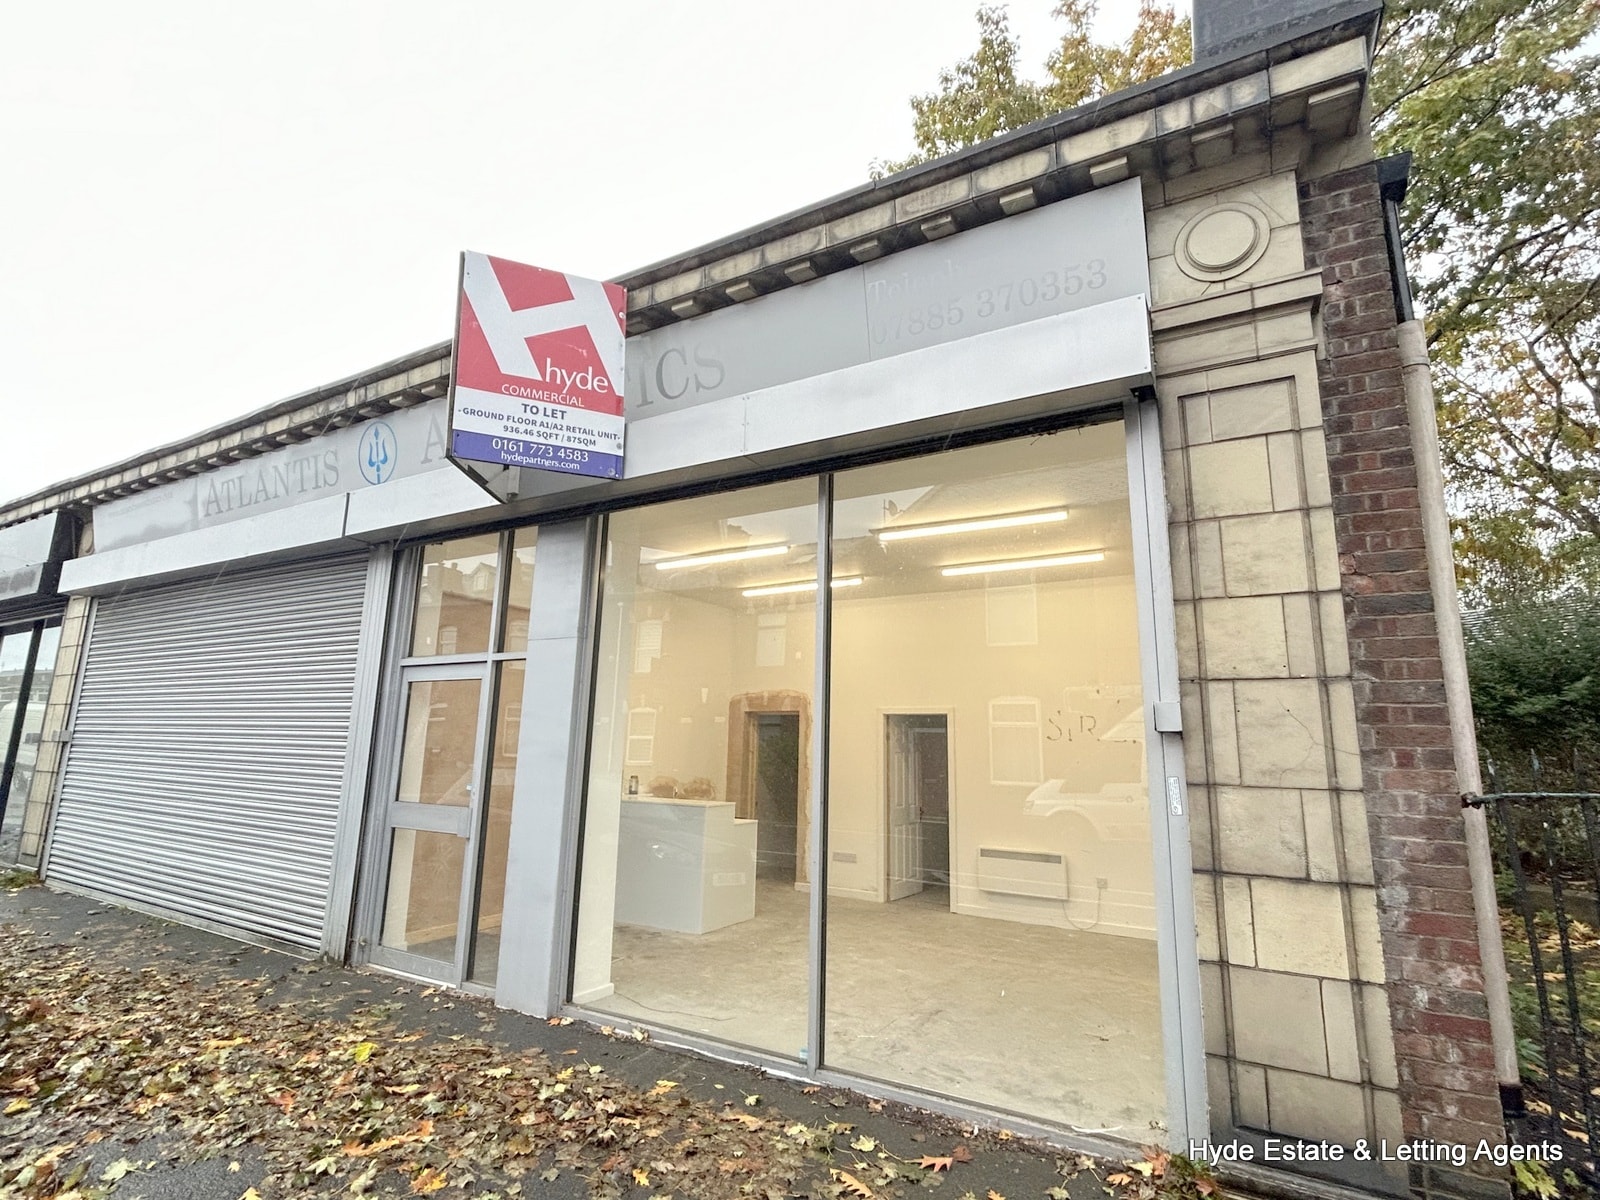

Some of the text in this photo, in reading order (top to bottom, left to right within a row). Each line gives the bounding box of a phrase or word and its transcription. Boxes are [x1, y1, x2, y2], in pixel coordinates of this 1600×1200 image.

[976, 258, 1107, 319] 370353
[545, 357, 608, 394] hyde
[501, 383, 585, 408] COMMERCIAL
[521, 403, 567, 420] TO LET
[203, 449, 340, 518] ATLANTIS
[625, 341, 726, 409] ICS
[503, 425, 534, 437] 936.46
[536, 430, 560, 441] SQFT
[566, 435, 596, 447] 87SQM
[506, 415, 537, 427] FLOOR
[539, 420, 564, 431] A1/A2
[566, 425, 595, 437] RETAIL
[492, 438, 588, 462] 0161 773 4583
[501, 451, 580, 470] hydepartners.com
